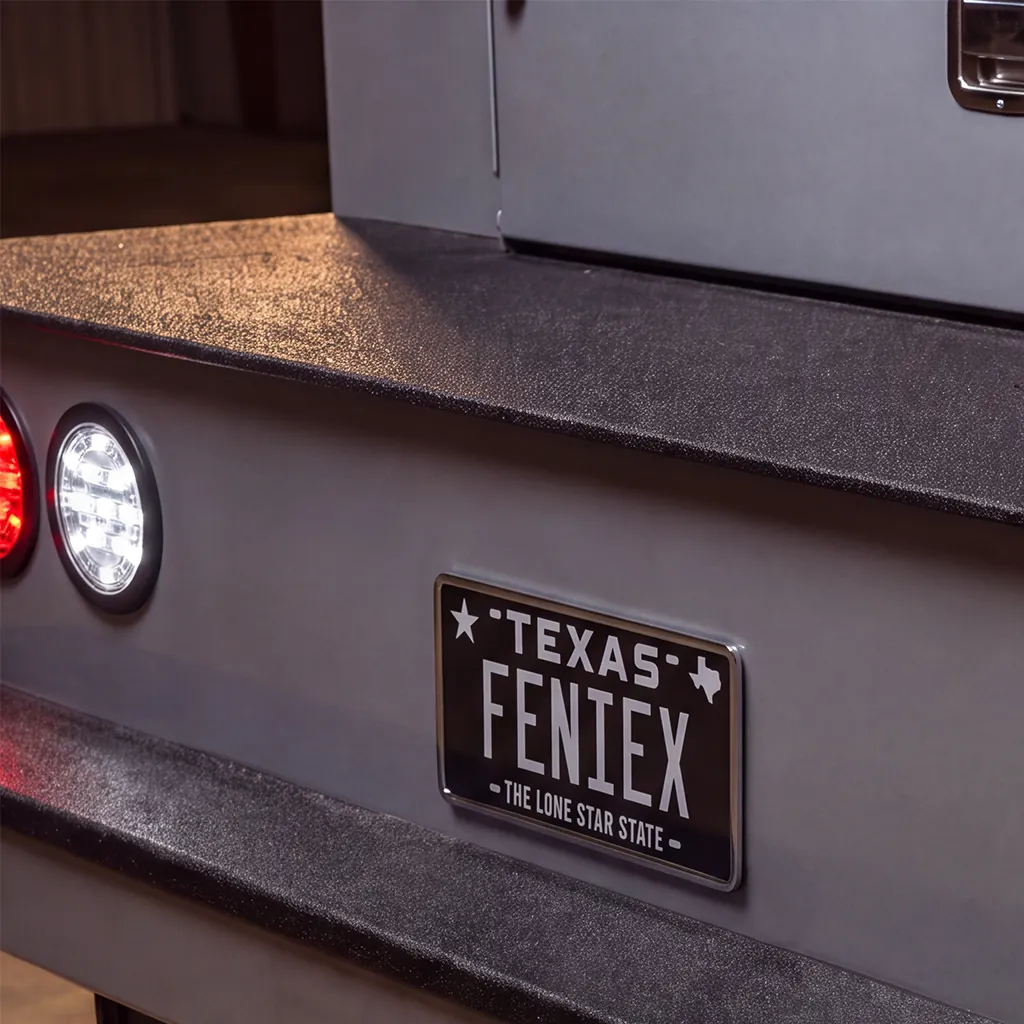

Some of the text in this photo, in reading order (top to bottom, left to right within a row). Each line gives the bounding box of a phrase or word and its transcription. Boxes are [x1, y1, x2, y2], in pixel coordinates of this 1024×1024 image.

[506, 609, 659, 689] TEXAS
[482, 659, 690, 819] FENIEX
[504, 780, 663, 852] THE LONE STAR STATE
